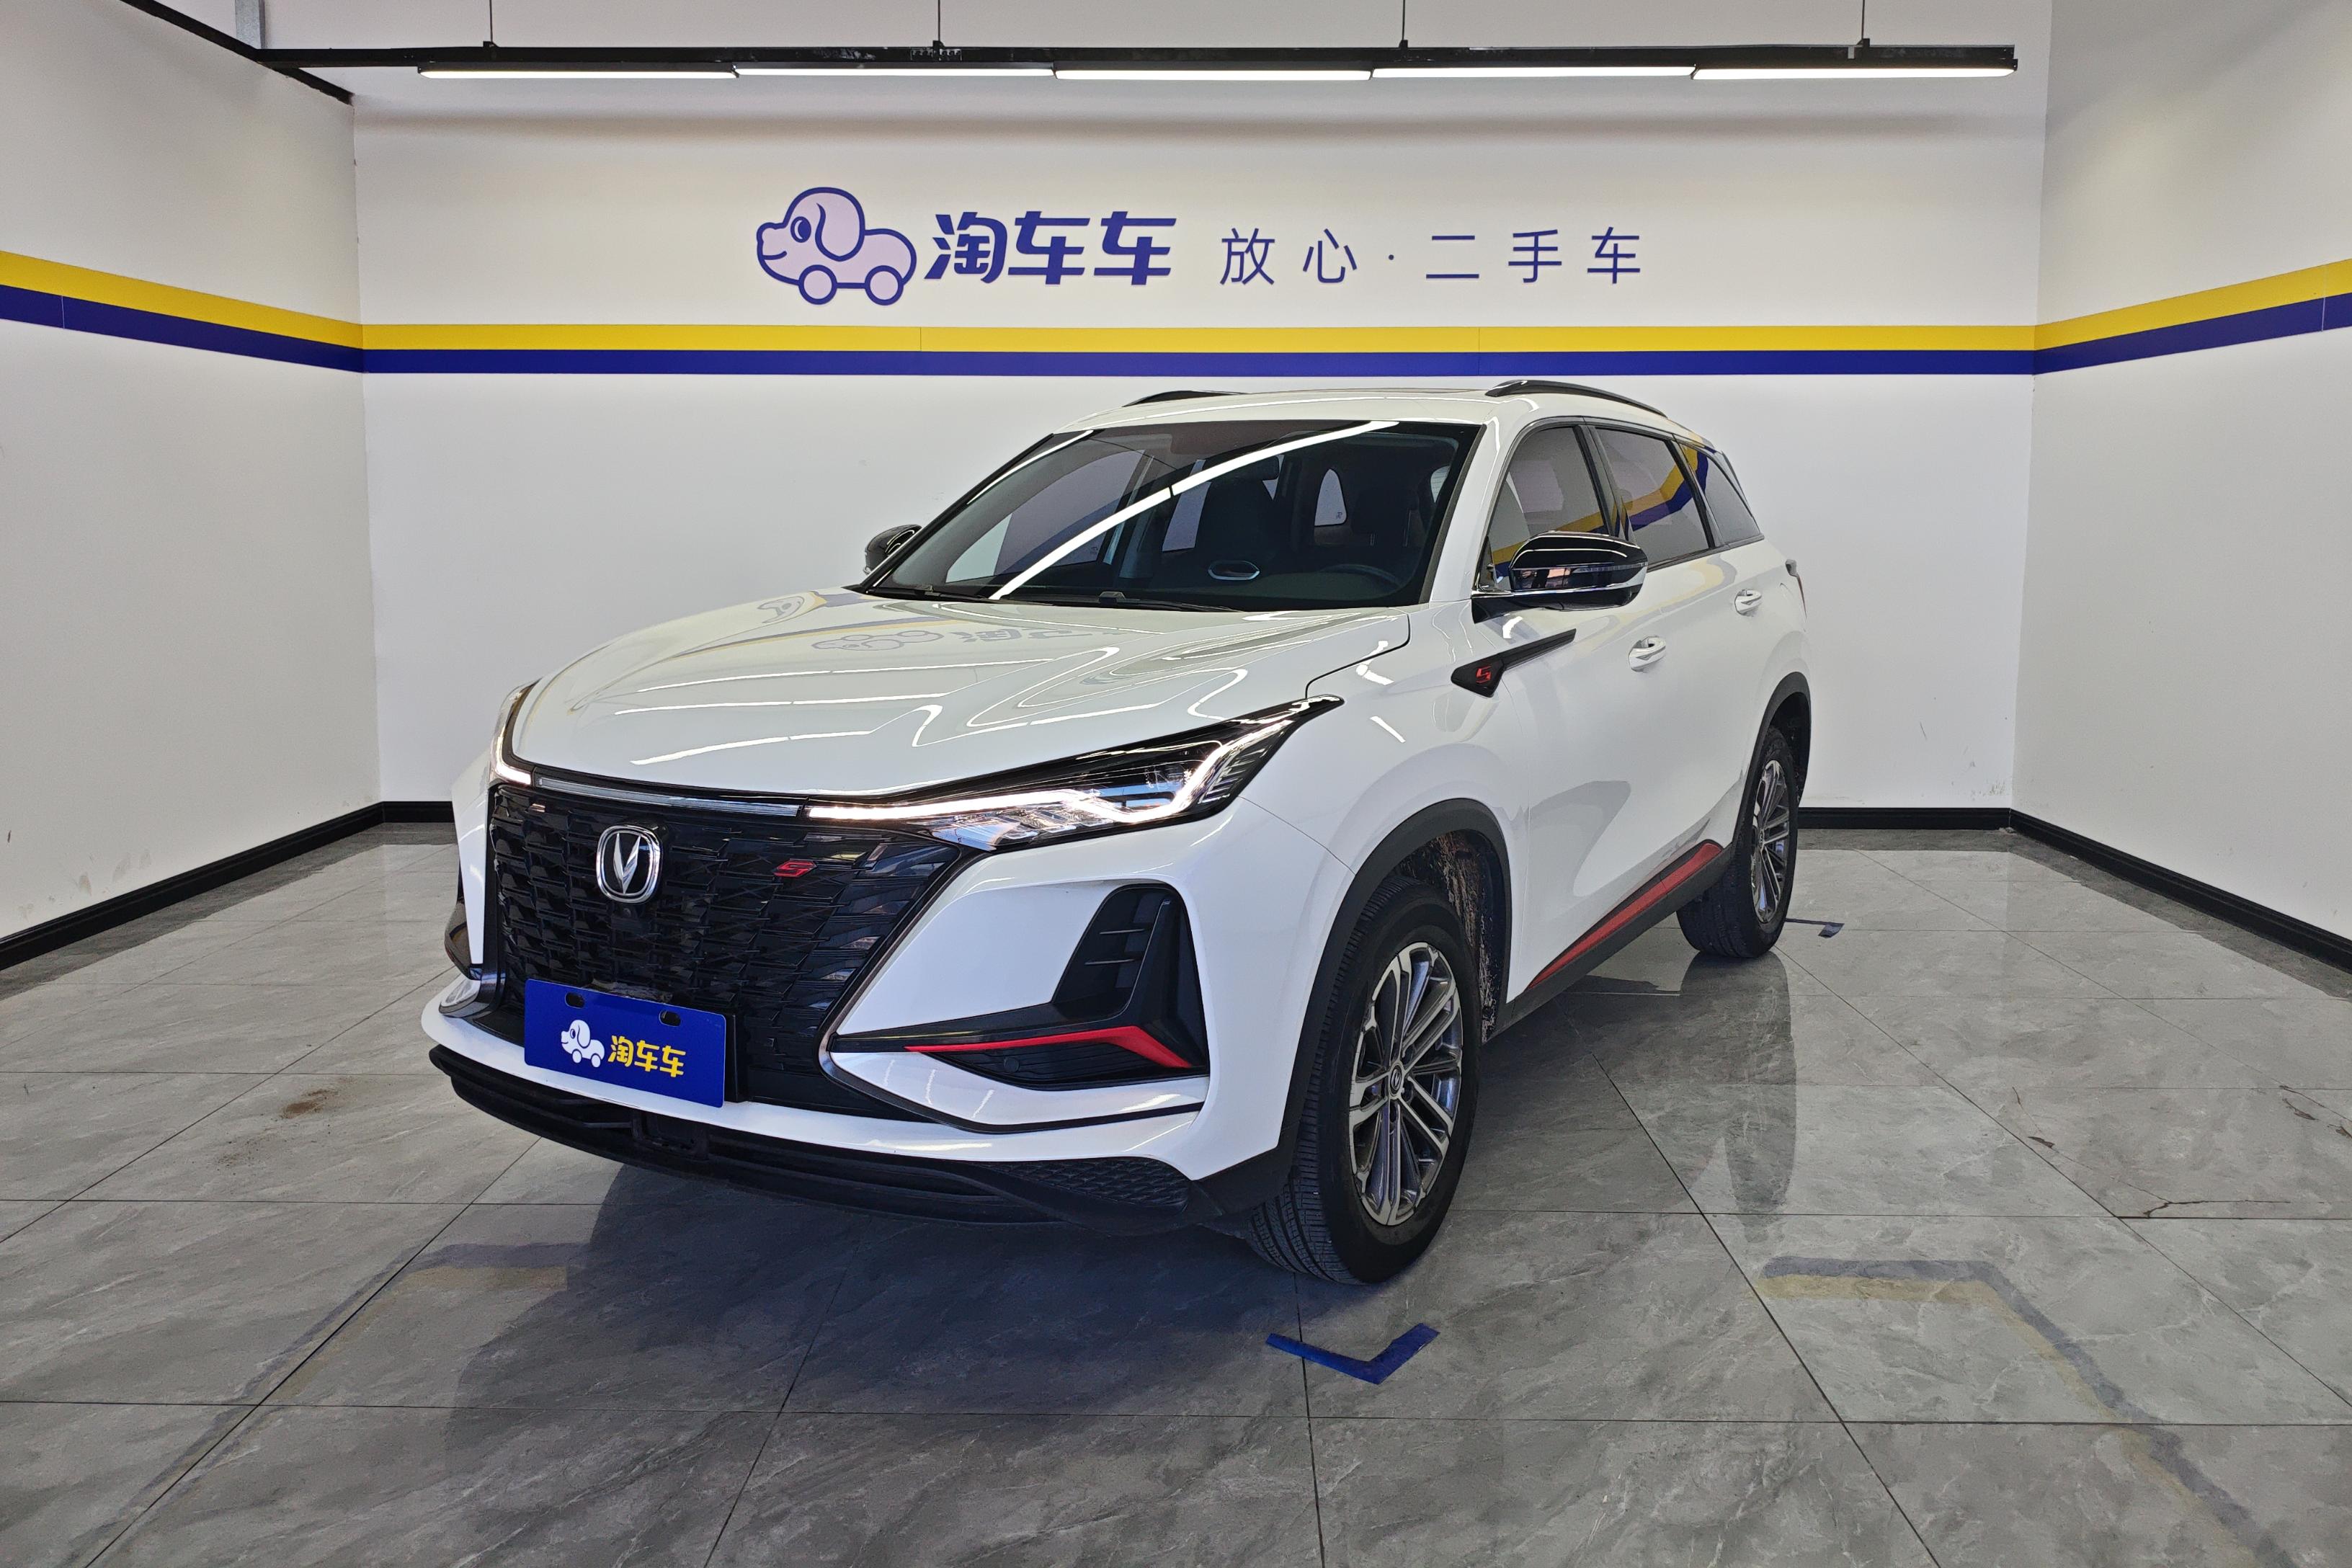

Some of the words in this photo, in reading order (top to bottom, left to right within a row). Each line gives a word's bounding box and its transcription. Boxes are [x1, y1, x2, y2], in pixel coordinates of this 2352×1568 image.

[924, 210, 1177, 285] 淘车车
[607, 1035, 686, 1078] 淘车车
